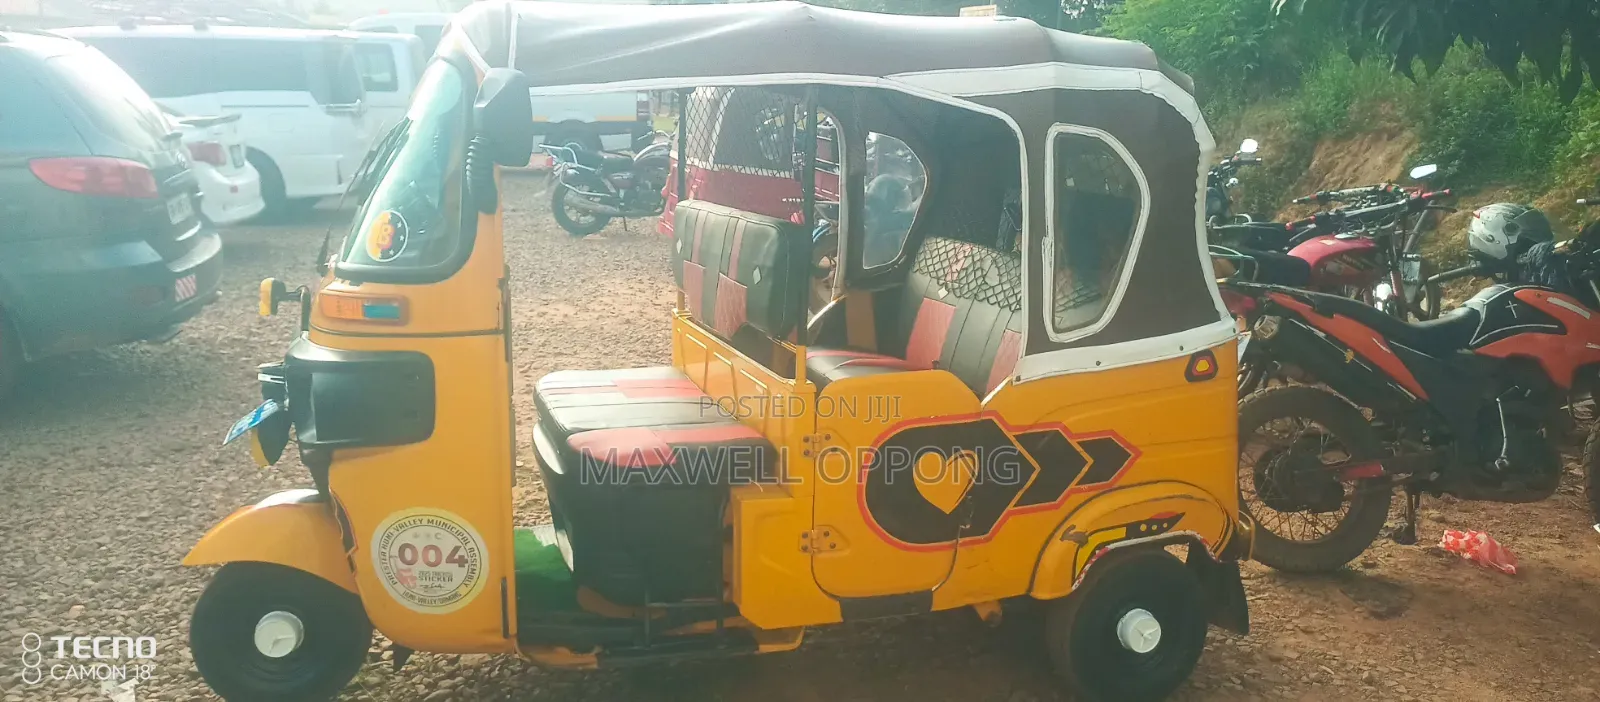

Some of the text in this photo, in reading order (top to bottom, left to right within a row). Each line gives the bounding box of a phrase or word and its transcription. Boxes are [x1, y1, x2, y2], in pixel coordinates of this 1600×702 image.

[397, 542, 469, 568] 004
[427, 518, 471, 549] MUNICIPAL
[463, 547, 478, 587] ASSEMBLY
[418, 575, 454, 583] STICKER
